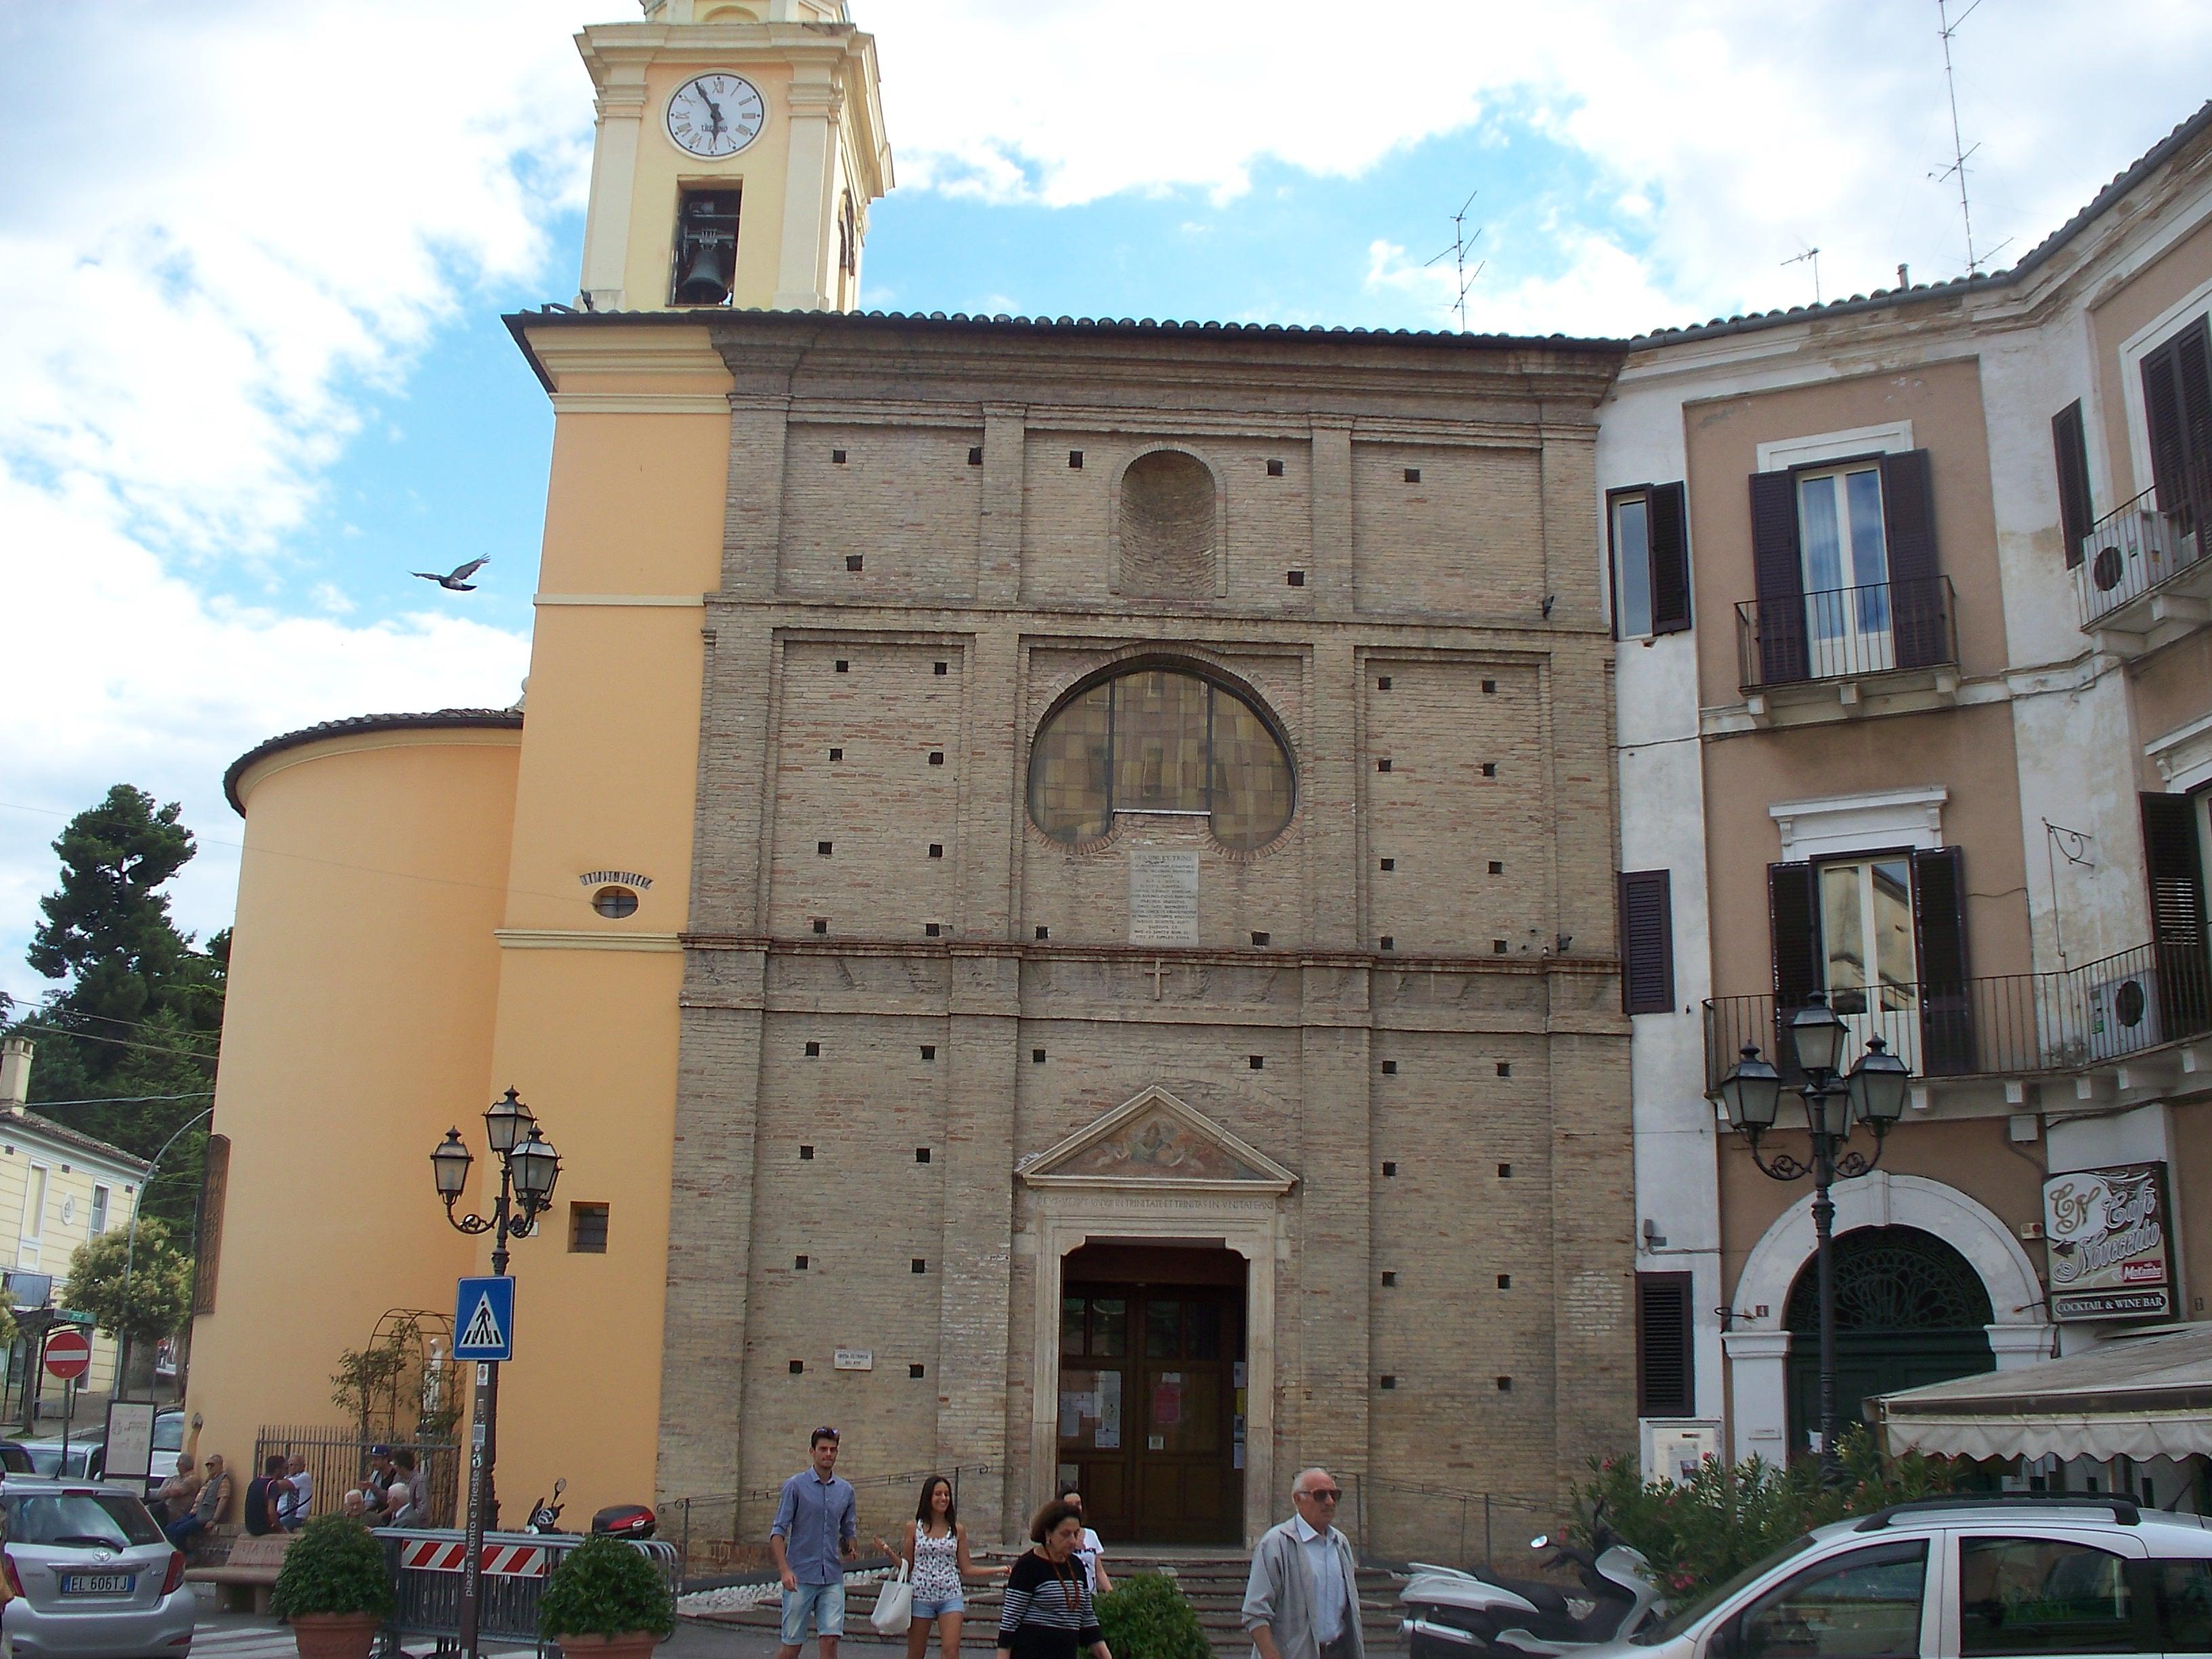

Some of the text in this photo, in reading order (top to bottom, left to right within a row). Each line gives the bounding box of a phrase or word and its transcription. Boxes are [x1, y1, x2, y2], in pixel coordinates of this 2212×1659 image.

[2053, 1218, 2160, 1282] Novecento
[2057, 1297, 2163, 1312] COCKTAIL & WINE BAR
[469, 1469, 479, 1508] Trieste
[467, 1521, 476, 1558] Trento
[71, 1577, 127, 1591] EL 606TJ
[466, 1561, 474, 1597] piazza
